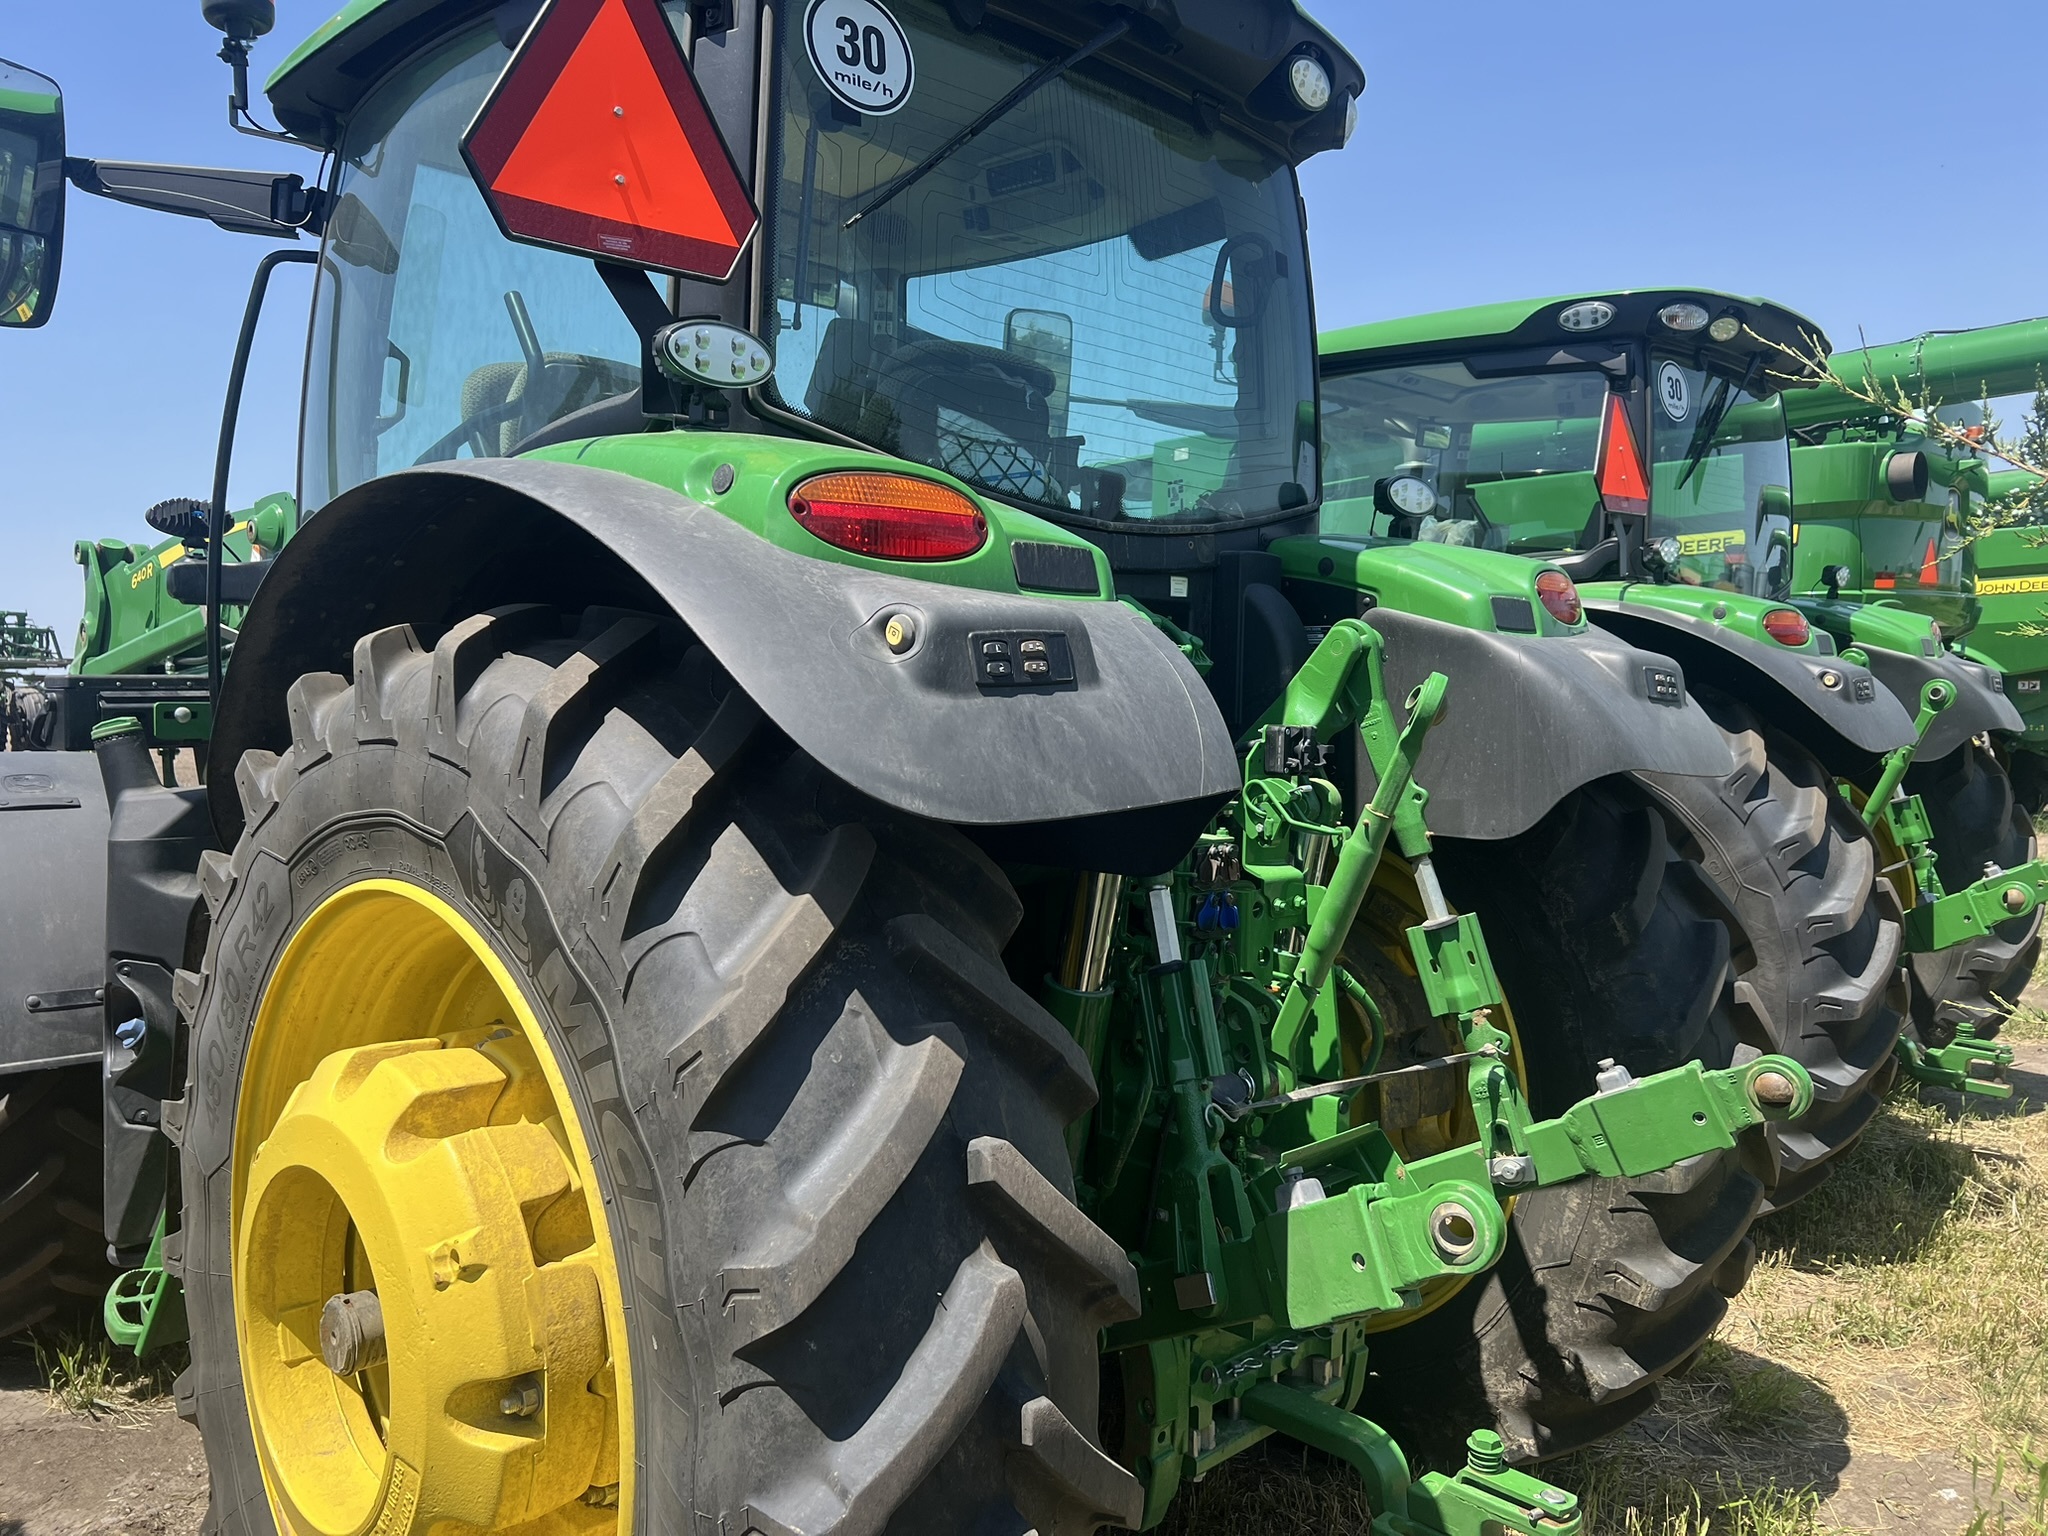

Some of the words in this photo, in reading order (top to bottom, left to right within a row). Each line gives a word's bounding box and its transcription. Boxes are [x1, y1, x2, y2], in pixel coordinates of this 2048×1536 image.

[836, 16, 887, 75] 30
[834, 71, 894, 98] mile/h
[1667, 376, 1682, 401] 30
[1978, 582, 2016, 593] JOHN
